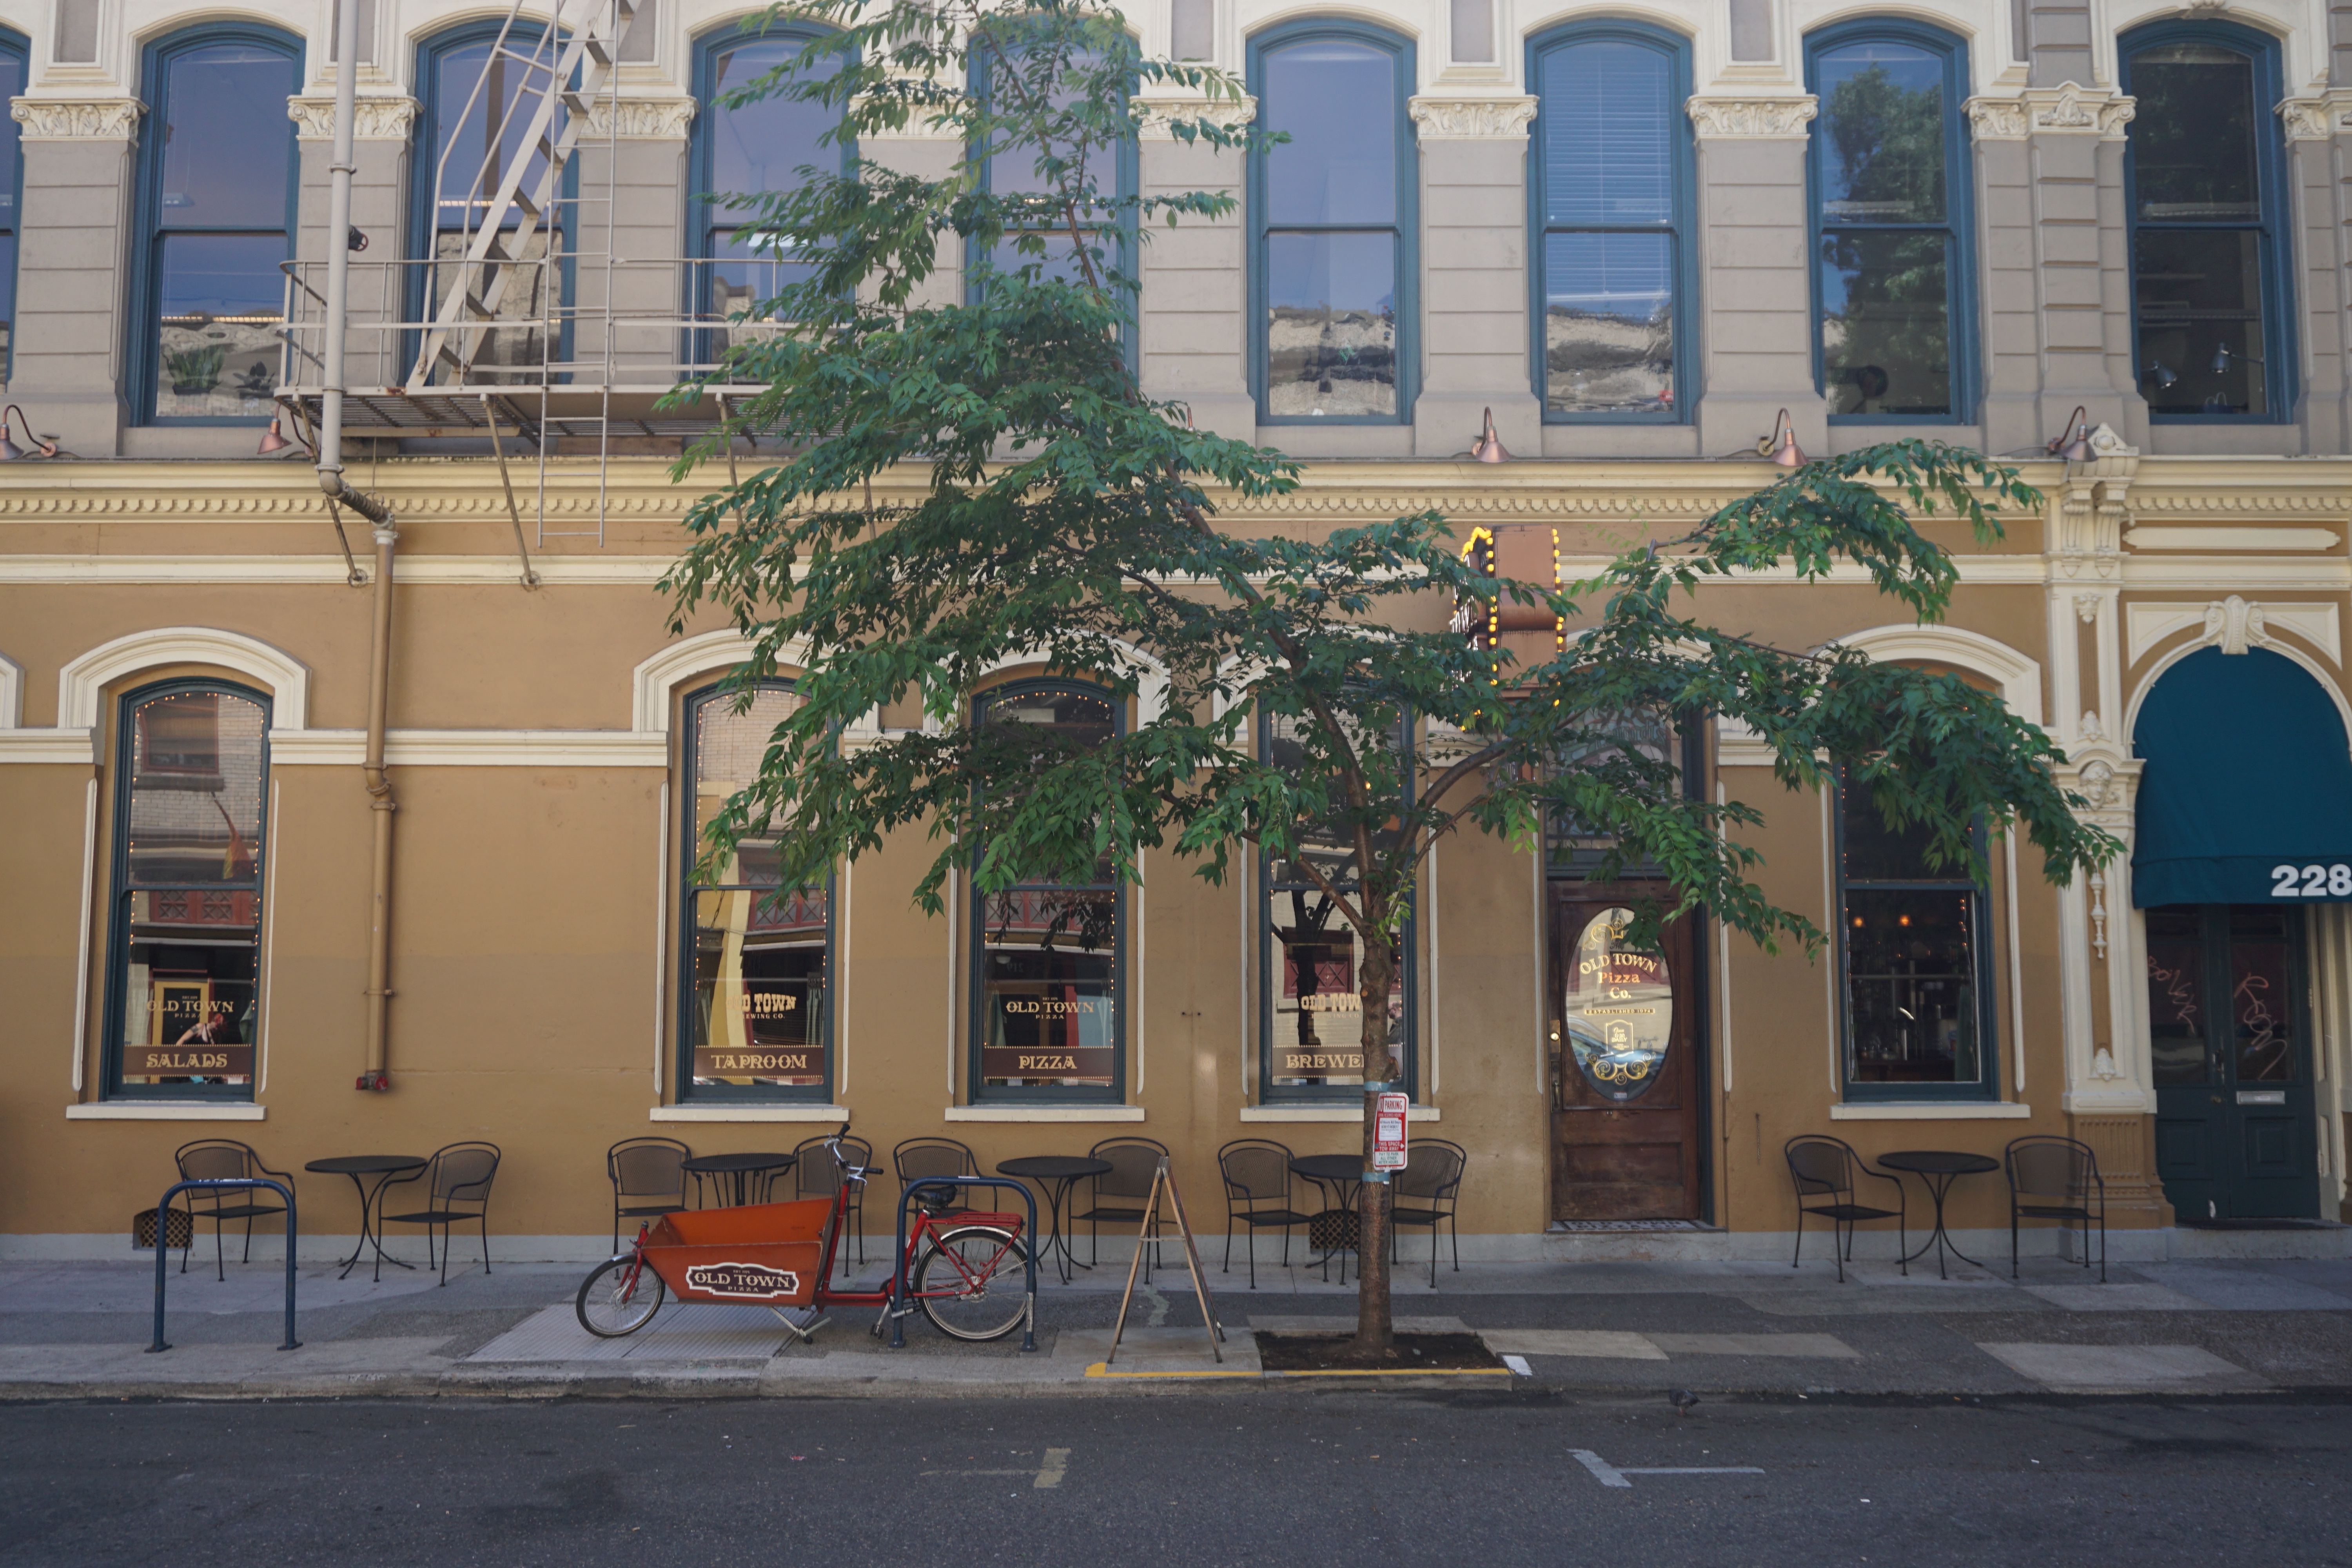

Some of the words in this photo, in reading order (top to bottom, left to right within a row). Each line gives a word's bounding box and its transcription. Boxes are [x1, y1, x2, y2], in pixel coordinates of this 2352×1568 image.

[2271, 864, 2352, 897] 228
[1580, 955, 1610, 974] OLD
[1613, 953, 1657, 973] TOWN
[1598, 972, 1641, 984] Pizza
[1610, 987, 1631, 999] Co.
[147, 1000, 179, 1011] OLD
[182, 1000, 234, 1013] TOWN
[726, 994, 750, 1013] OLD
[754, 993, 796, 1013] TOWN
[1006, 1002, 1039, 1013] OLD
[1043, 1002, 1094, 1013] TOWN
[1301, 994, 1326, 1012] OLD
[1330, 993, 1361, 1012] TOW
[146, 1053, 227, 1067] SALADS
[711, 1054, 806, 1069] TAPROOM
[1019, 1056, 1077, 1069] PIZZA
[1286, 1054, 1364, 1068] BREWE
[1378, 1098, 1383, 1112] NO
[1385, 1100, 1403, 1110] PARKING
[694, 1272, 730, 1284] OLD
[734, 1274, 791, 1289] TOWN
